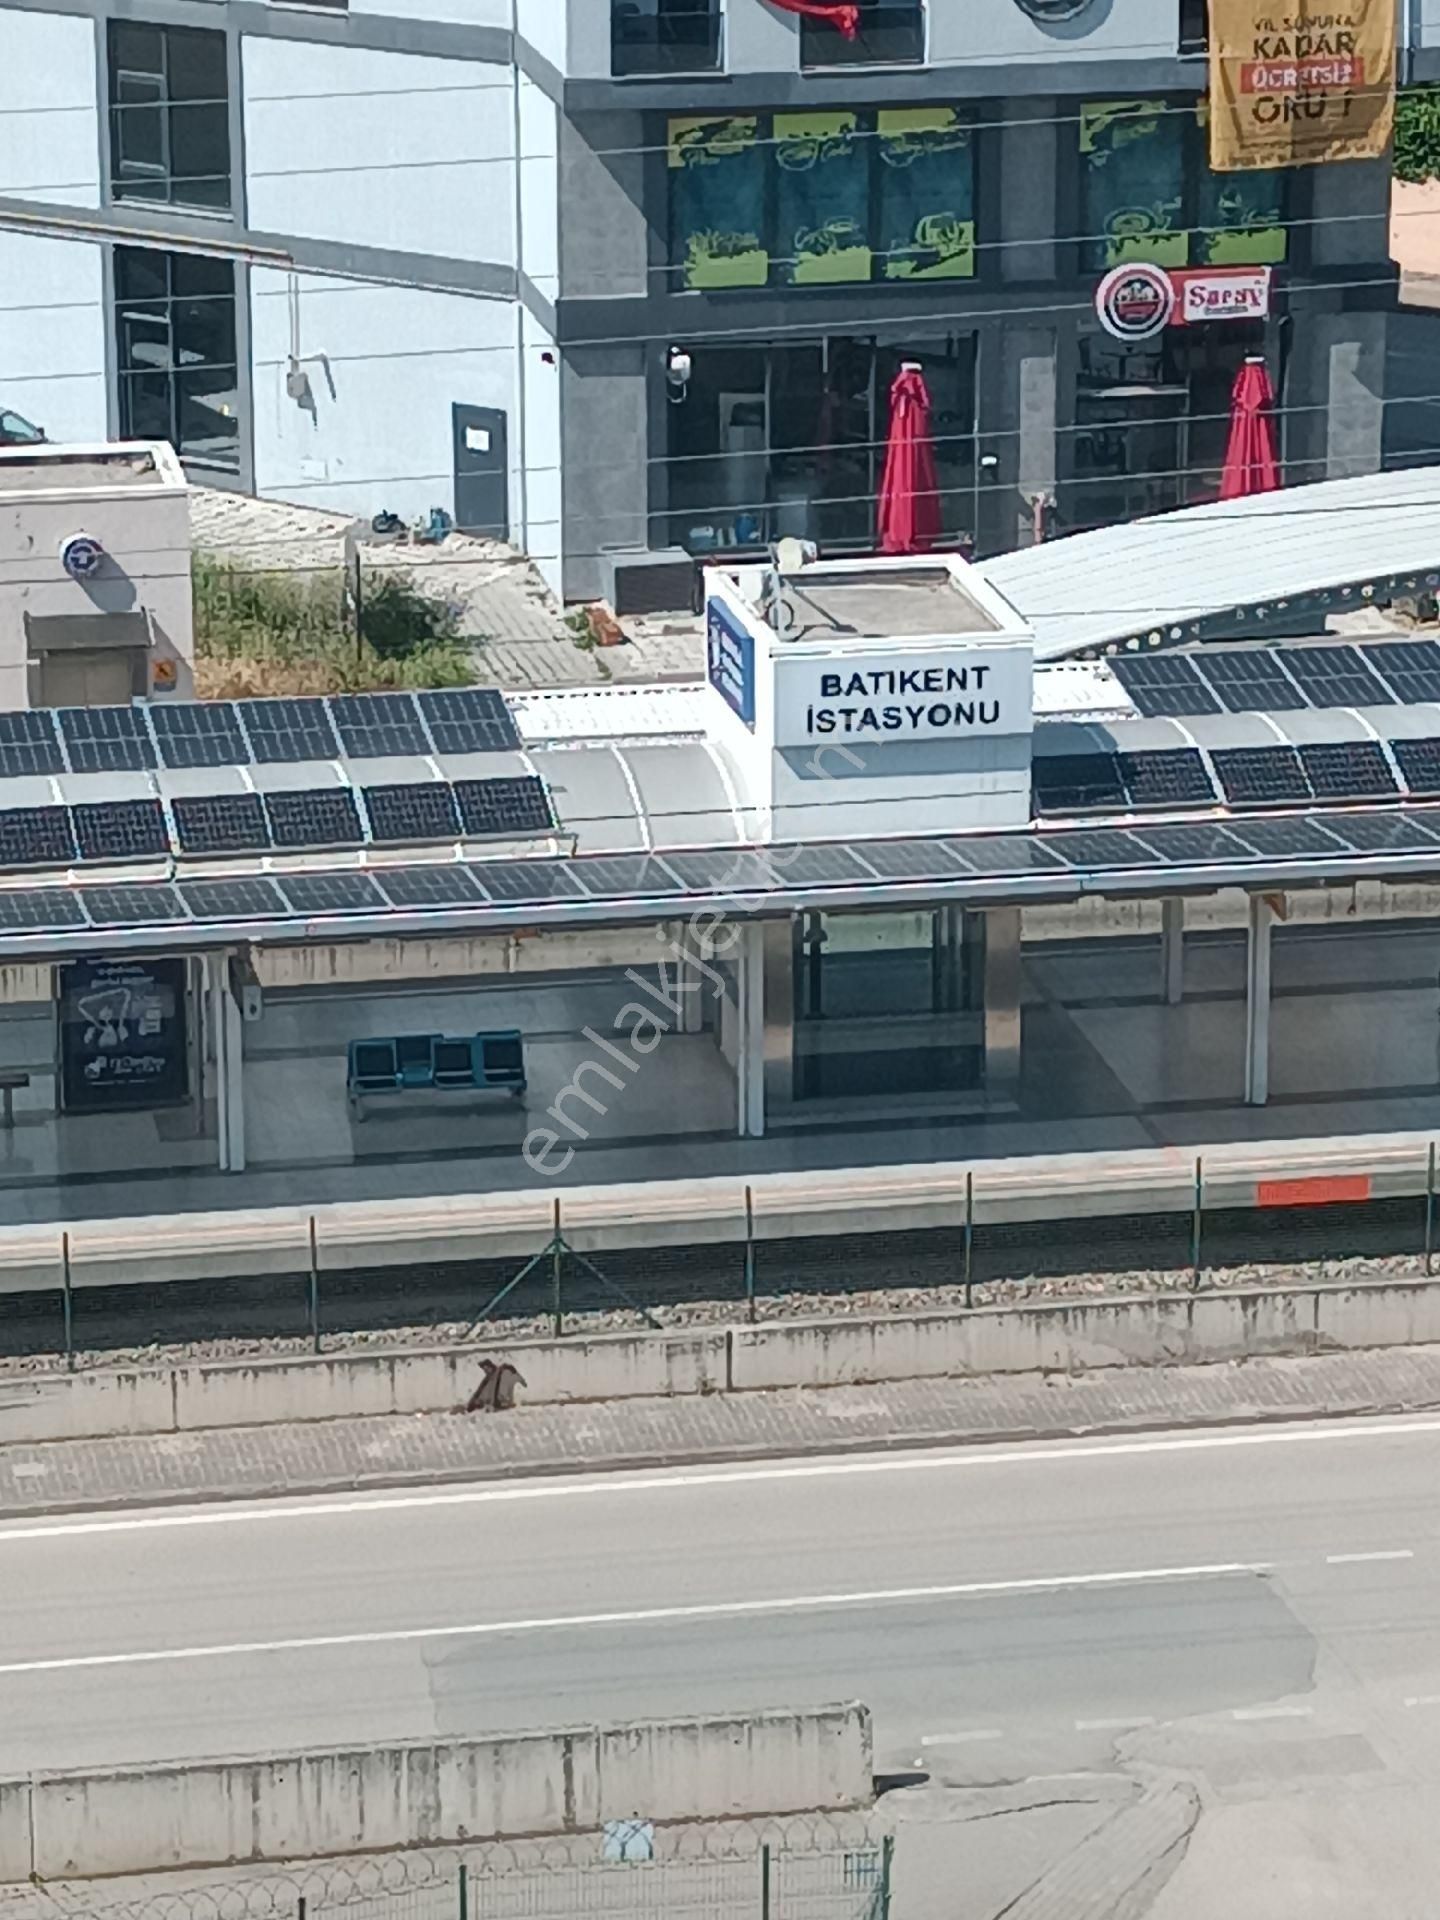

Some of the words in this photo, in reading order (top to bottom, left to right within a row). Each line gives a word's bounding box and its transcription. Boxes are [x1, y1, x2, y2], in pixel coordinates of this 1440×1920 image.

[1253, 31, 1355, 59] KADAR
[1189, 285, 1262, 308] Saray
[820, 665, 991, 698] BATIKENT
[806, 699, 1001, 735] İSTASYONU
